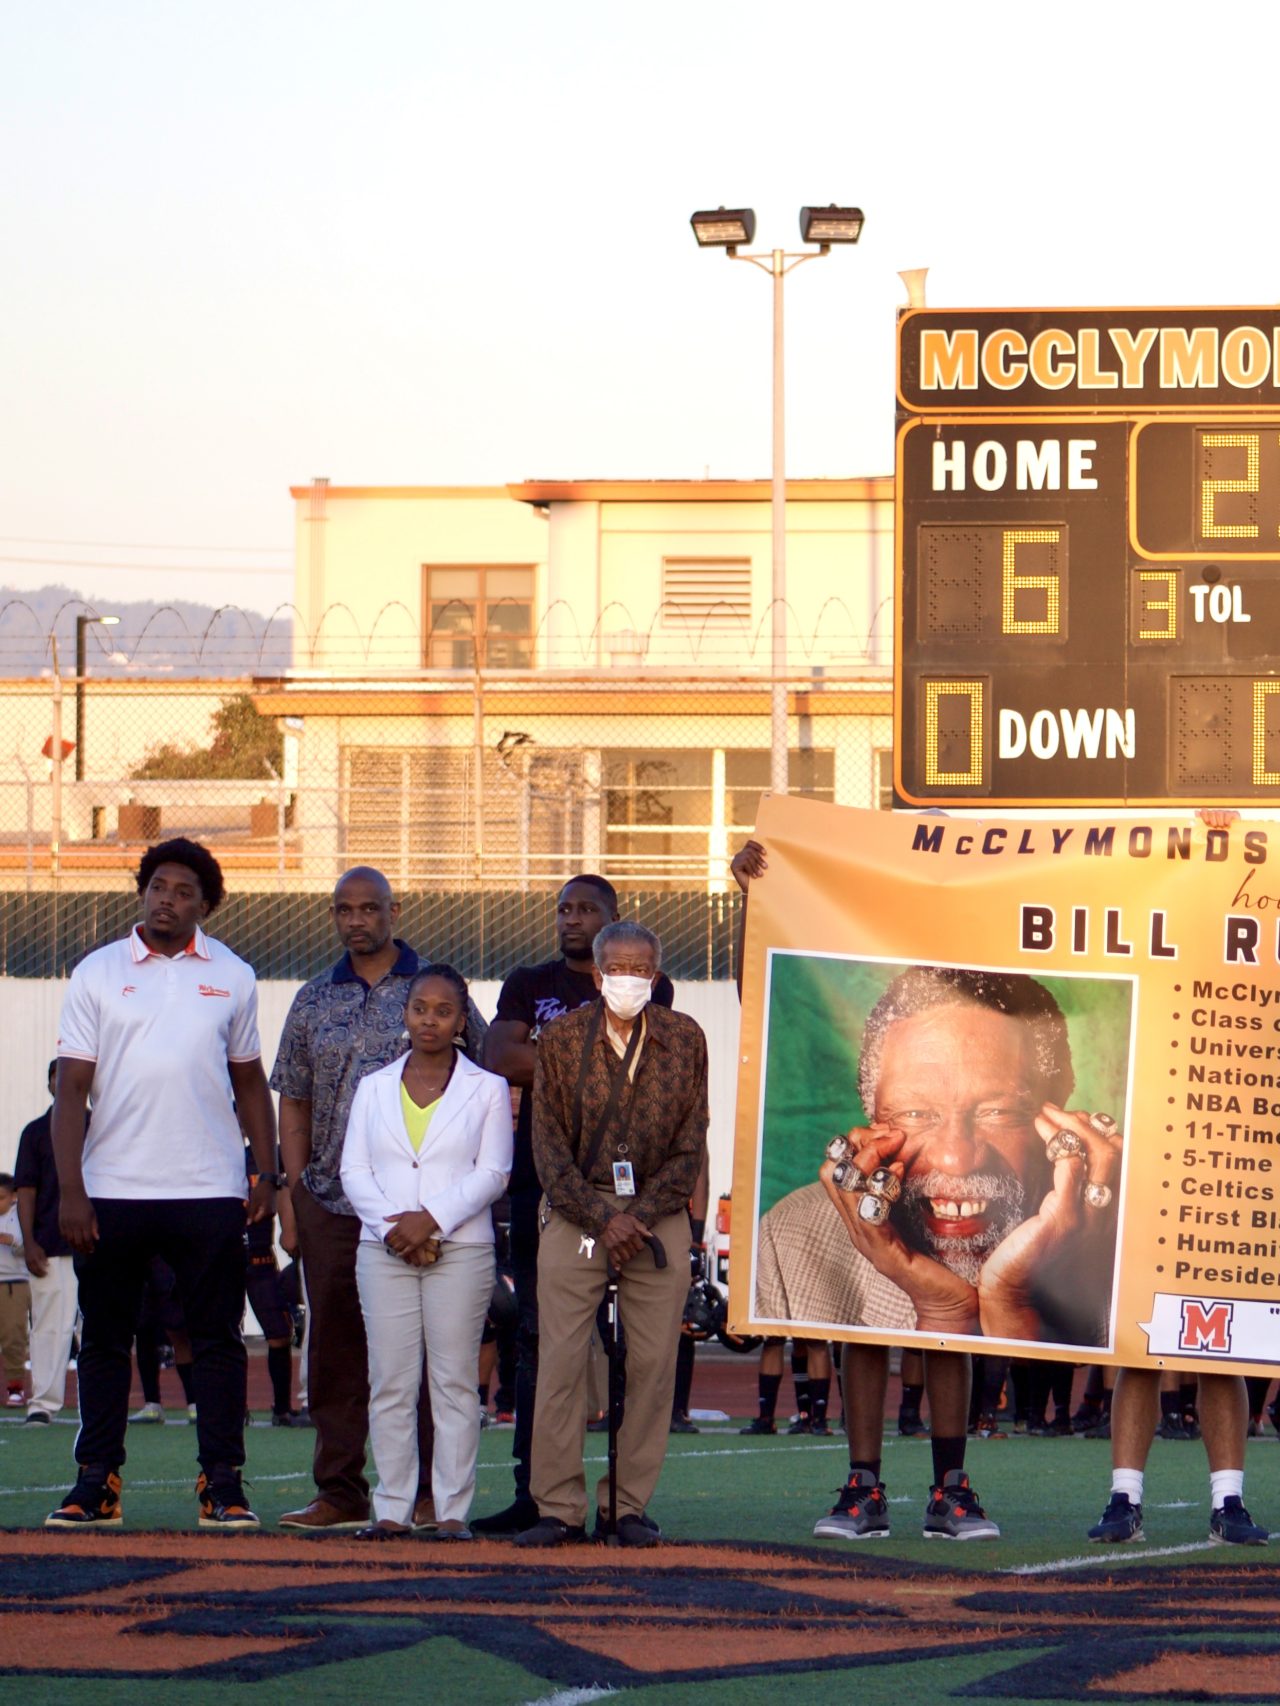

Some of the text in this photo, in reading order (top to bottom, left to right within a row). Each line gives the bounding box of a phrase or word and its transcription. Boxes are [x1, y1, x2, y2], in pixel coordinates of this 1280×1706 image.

[932, 439, 1098, 491] HOME
[1002, 530, 1060, 634] 6
[1139, 572, 1177, 639] 3
[1189, 585, 1251, 623] TOL
[925, 682, 984, 786] 0
[999, 708, 1136, 760] DOWN
[1020, 904, 1178, 960] BILL
[1191, 1008, 1263, 1031] Class
[1186, 1092, 1242, 1114] NBA
[1182, 1148, 1273, 1173] 5-Time
[1180, 1176, 1274, 1201] Celtics
[1178, 1204, 1241, 1227] First
[1178, 1299, 1234, 1354] M
